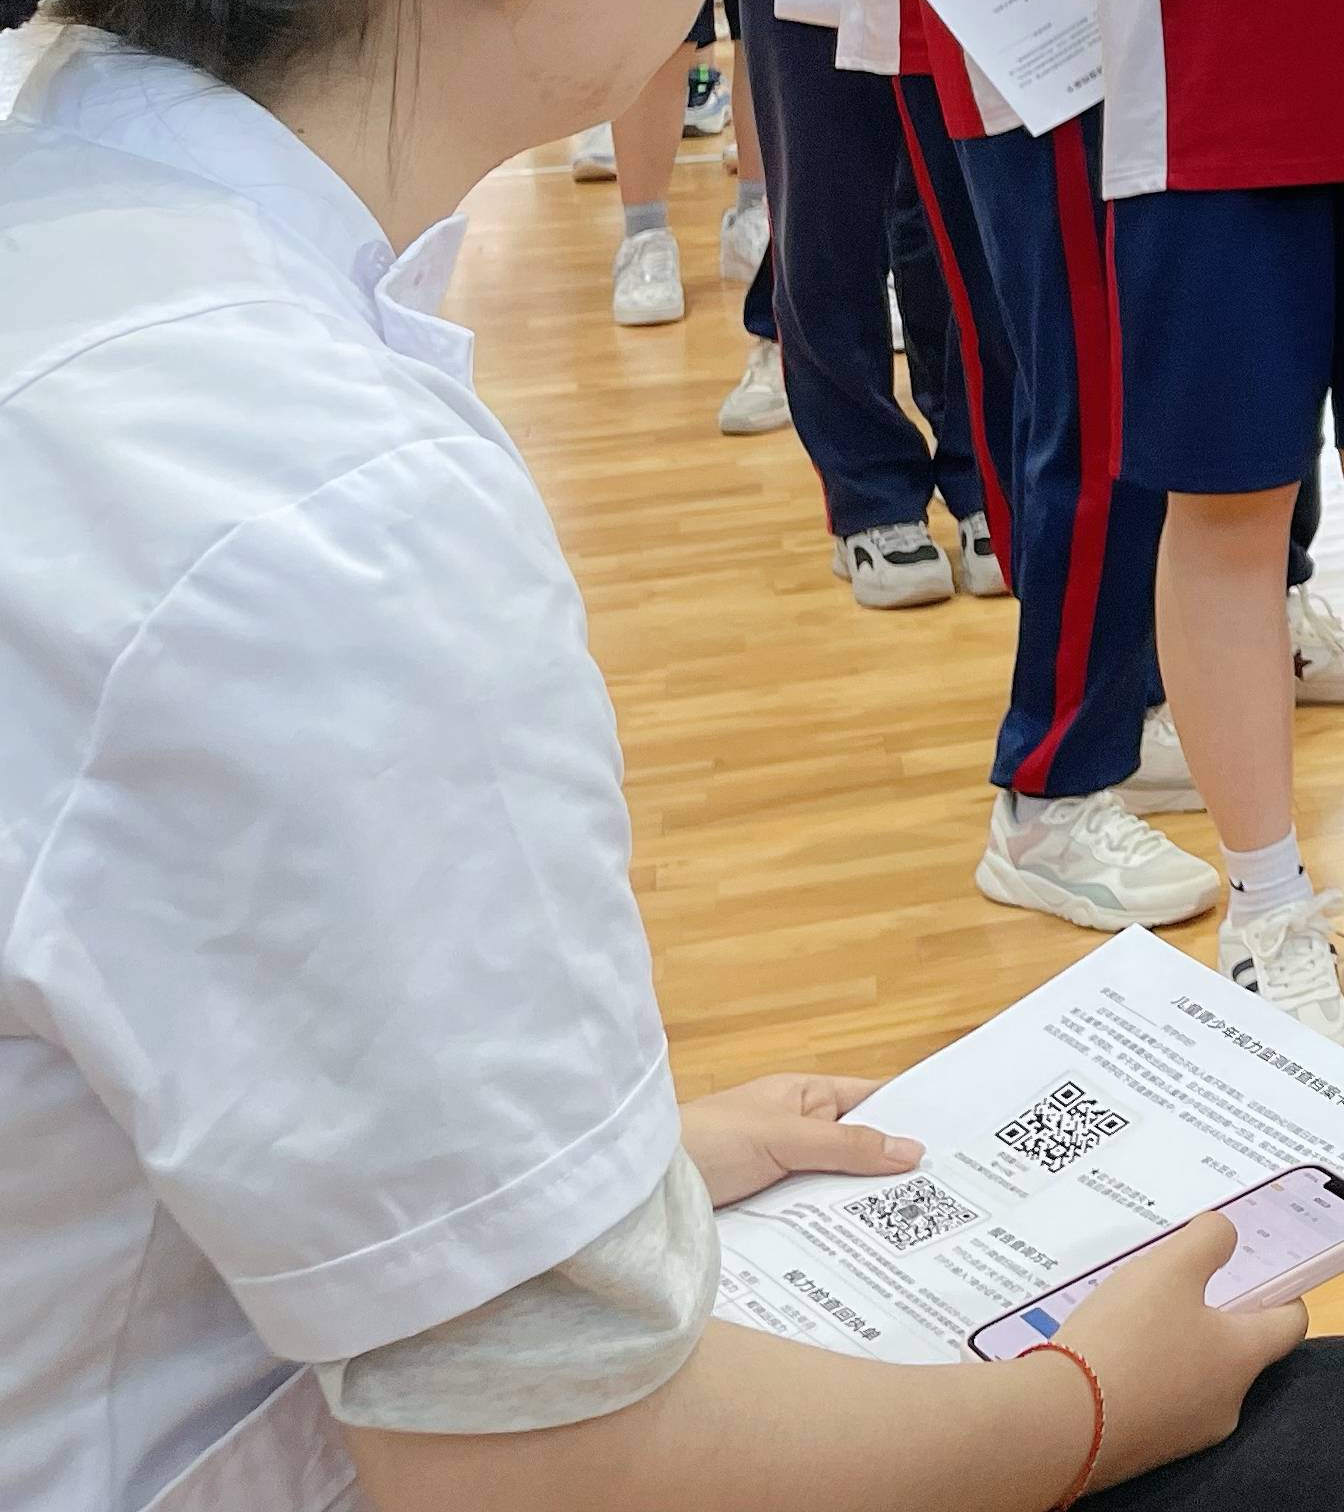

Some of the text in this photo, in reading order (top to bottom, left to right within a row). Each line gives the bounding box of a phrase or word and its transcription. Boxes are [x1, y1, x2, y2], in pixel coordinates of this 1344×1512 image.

[781, 1267, 884, 1341] 视力检查回执单
